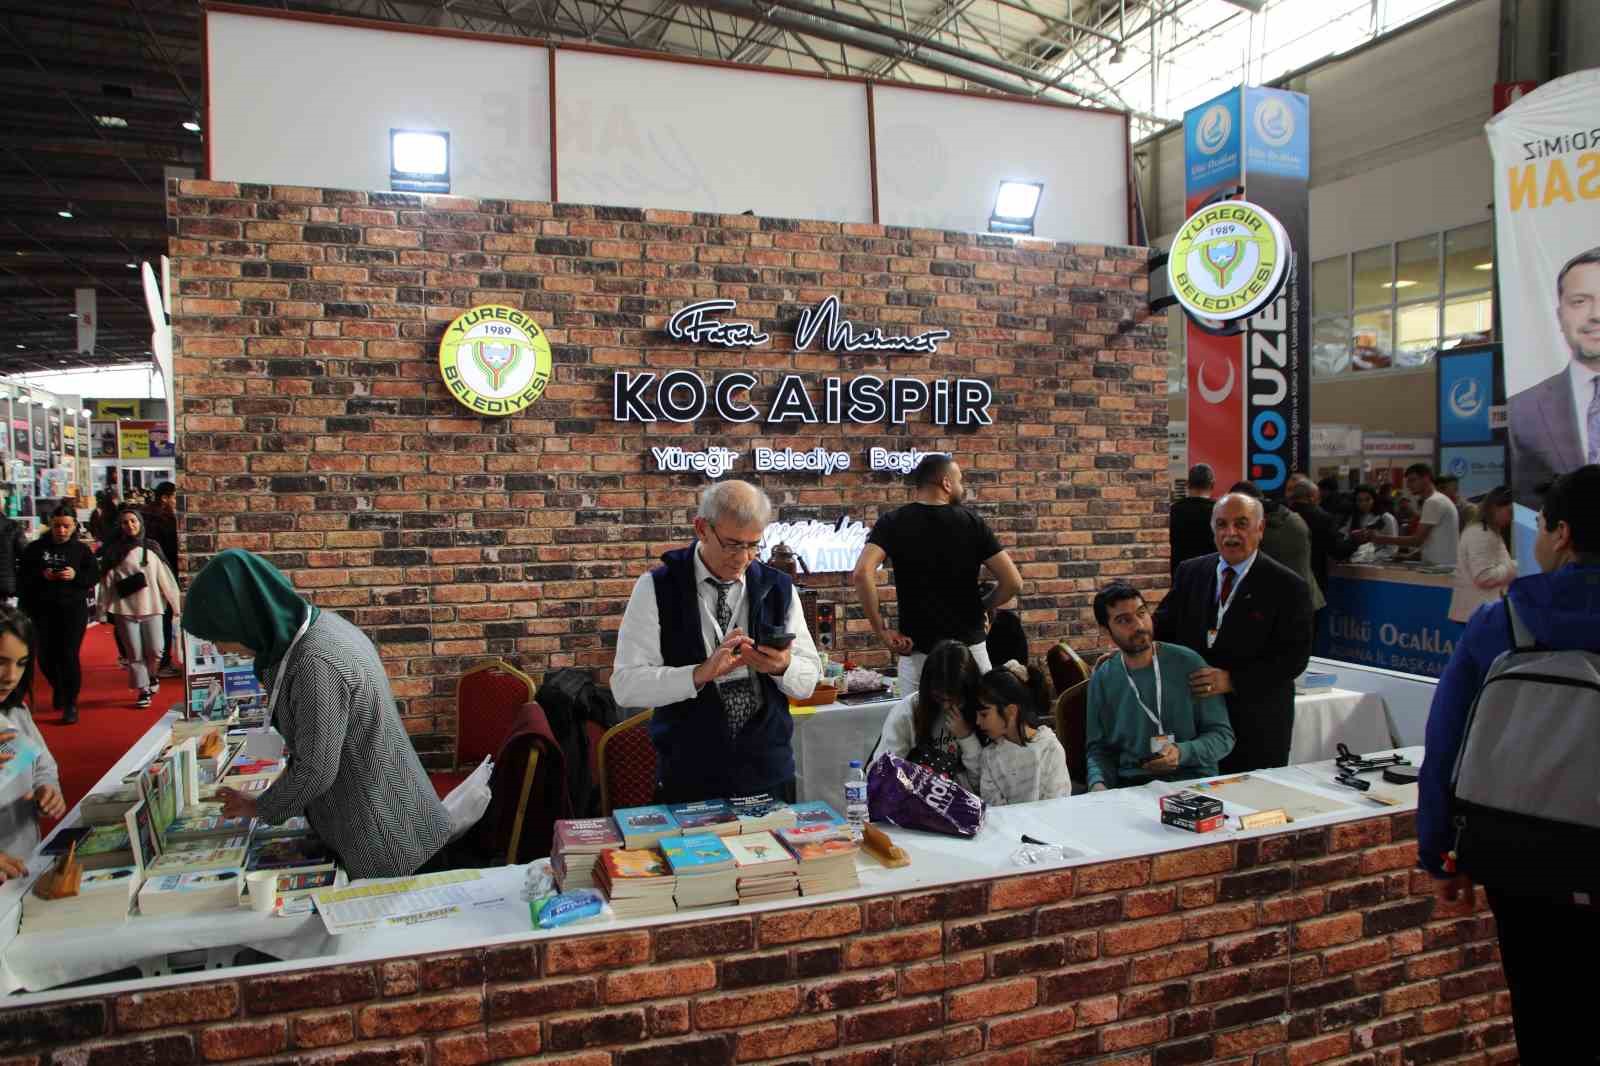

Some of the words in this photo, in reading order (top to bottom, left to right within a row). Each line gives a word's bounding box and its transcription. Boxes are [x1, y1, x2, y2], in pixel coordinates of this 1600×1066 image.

[1210, 225, 1236, 237] 1989
[483, 324, 513, 336] 1989
[797, 295, 950, 352] Mehmet
[652, 446, 739, 477] Yüreğir
[755, 448, 850, 475] Belediye
[870, 447, 942, 474] Başk
[1378, 623, 1455, 655] Ocakla
